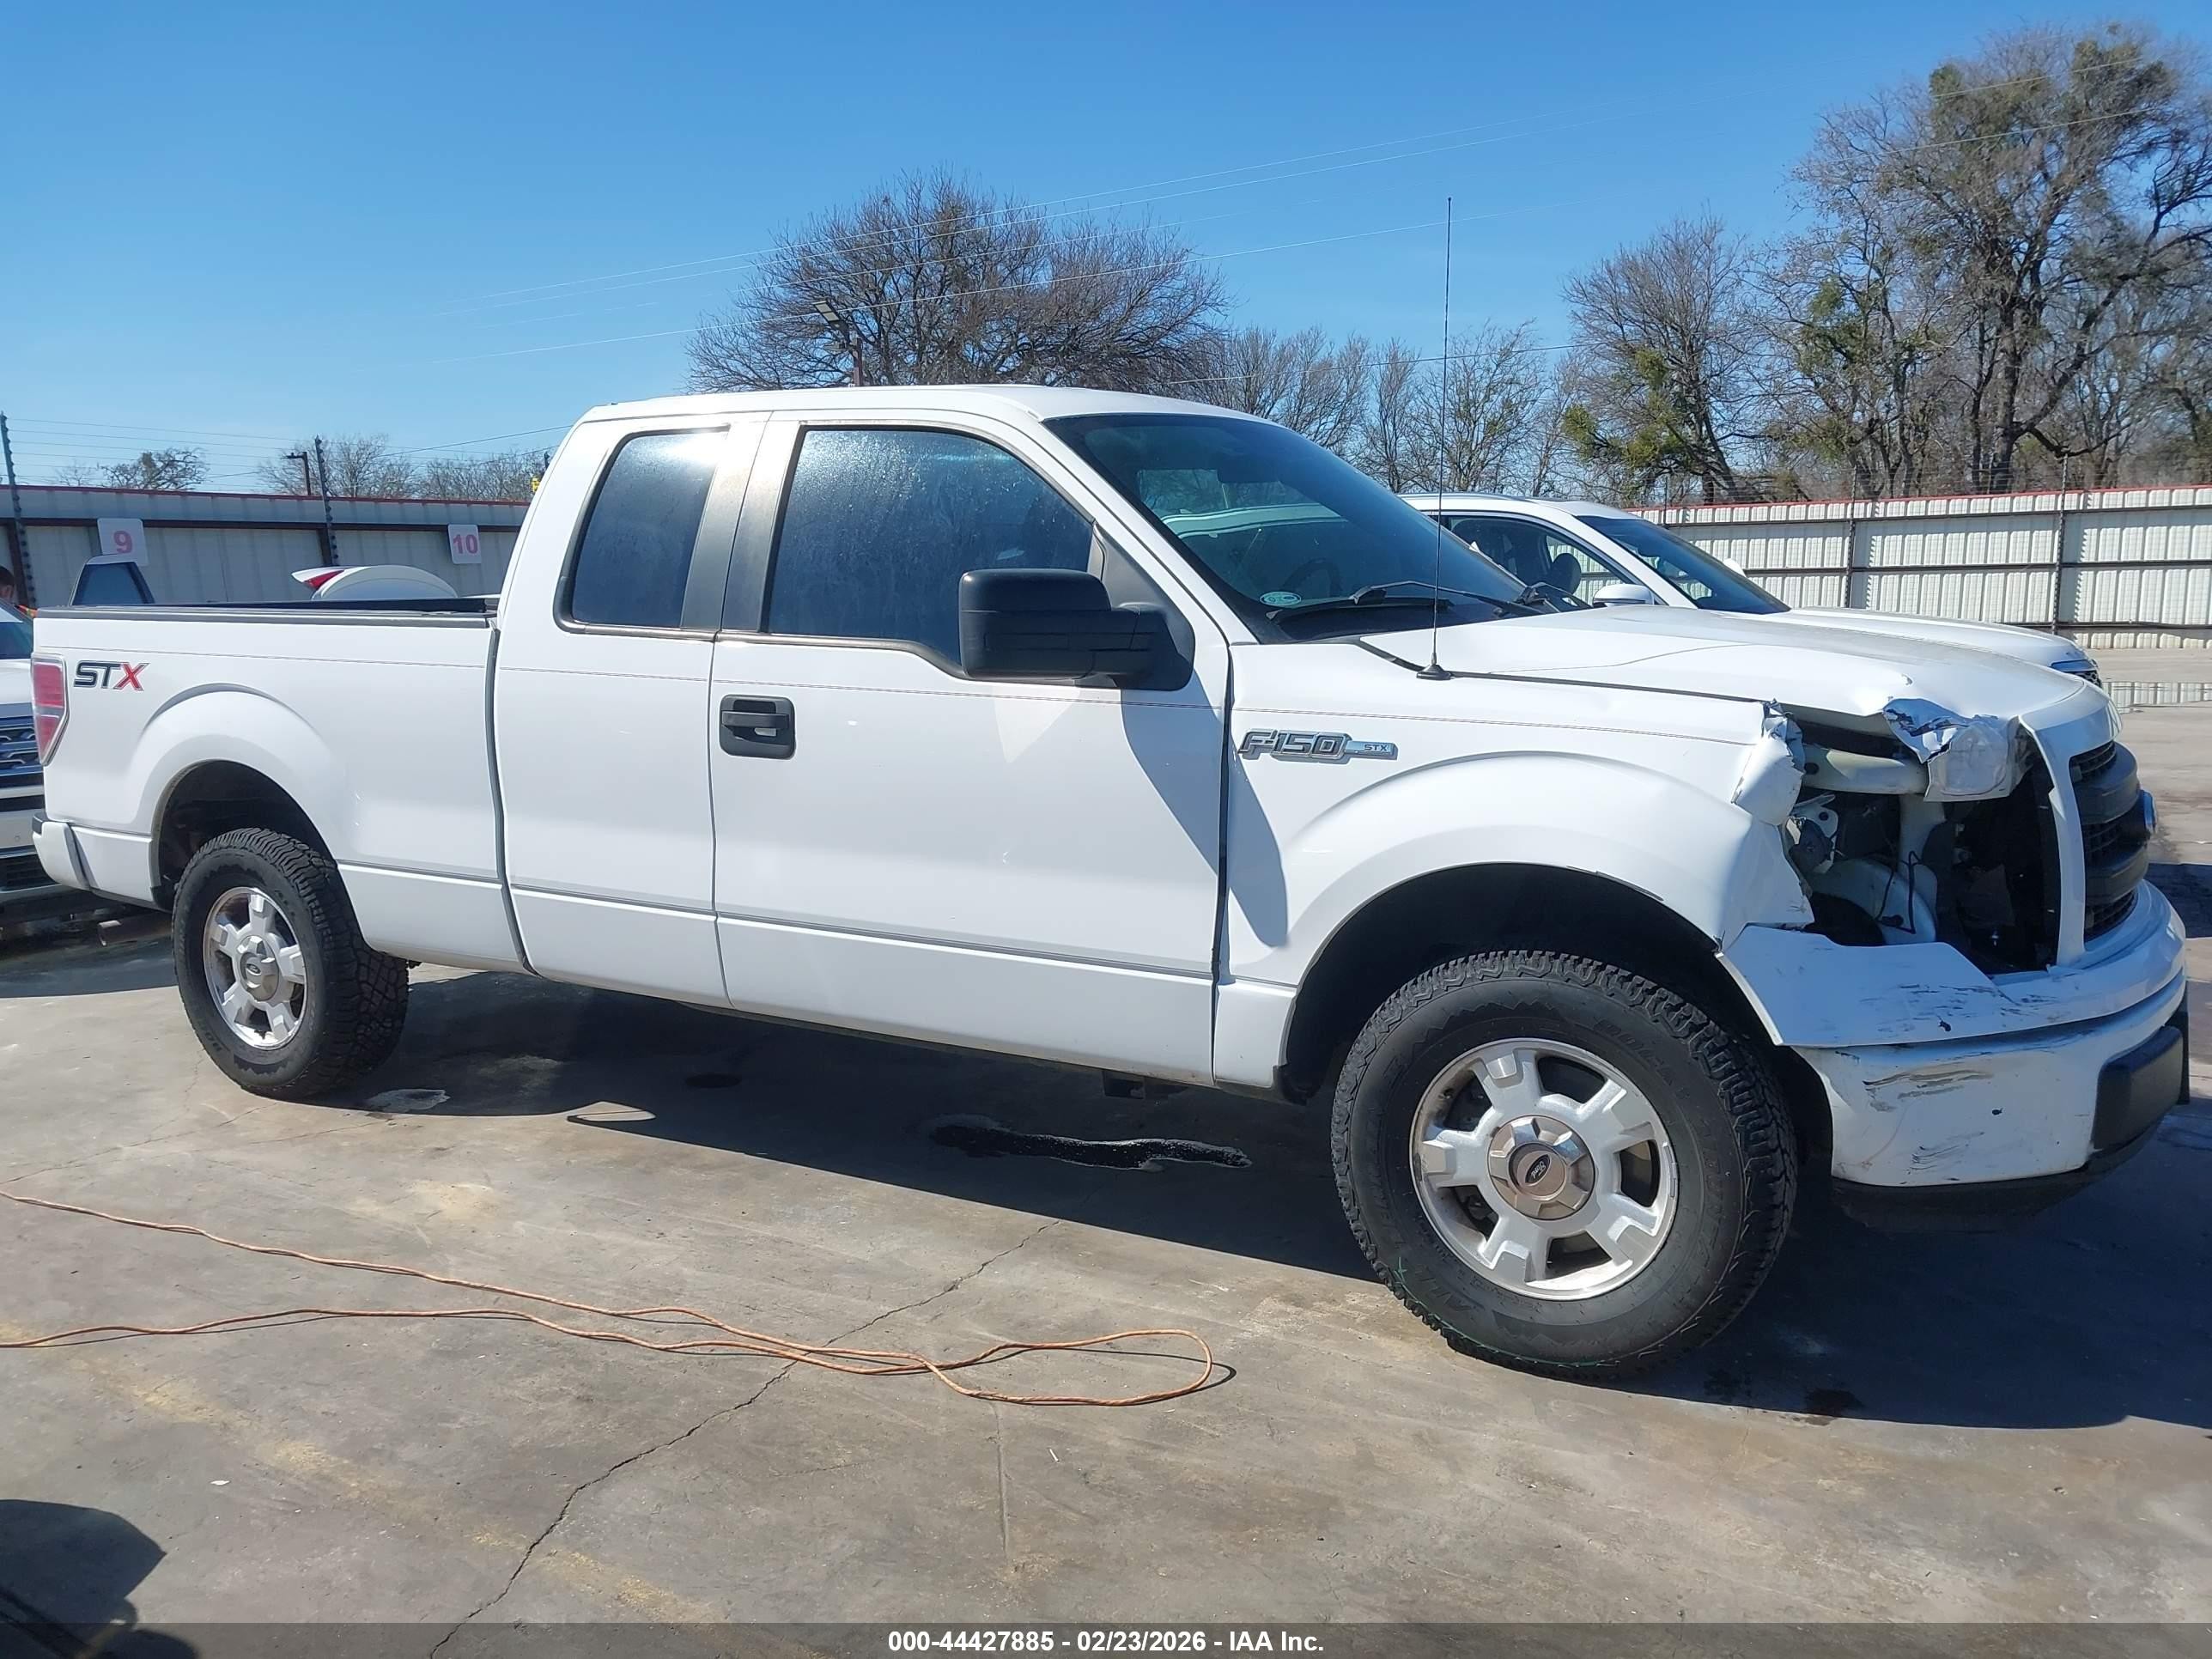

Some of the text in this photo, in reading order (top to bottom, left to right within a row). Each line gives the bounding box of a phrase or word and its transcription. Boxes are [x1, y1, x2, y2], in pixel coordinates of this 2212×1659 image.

[112, 529, 133, 555] 9
[452, 532, 479, 556] 10
[73, 659, 151, 691] STX
[1363, 743, 1389, 752] STX
